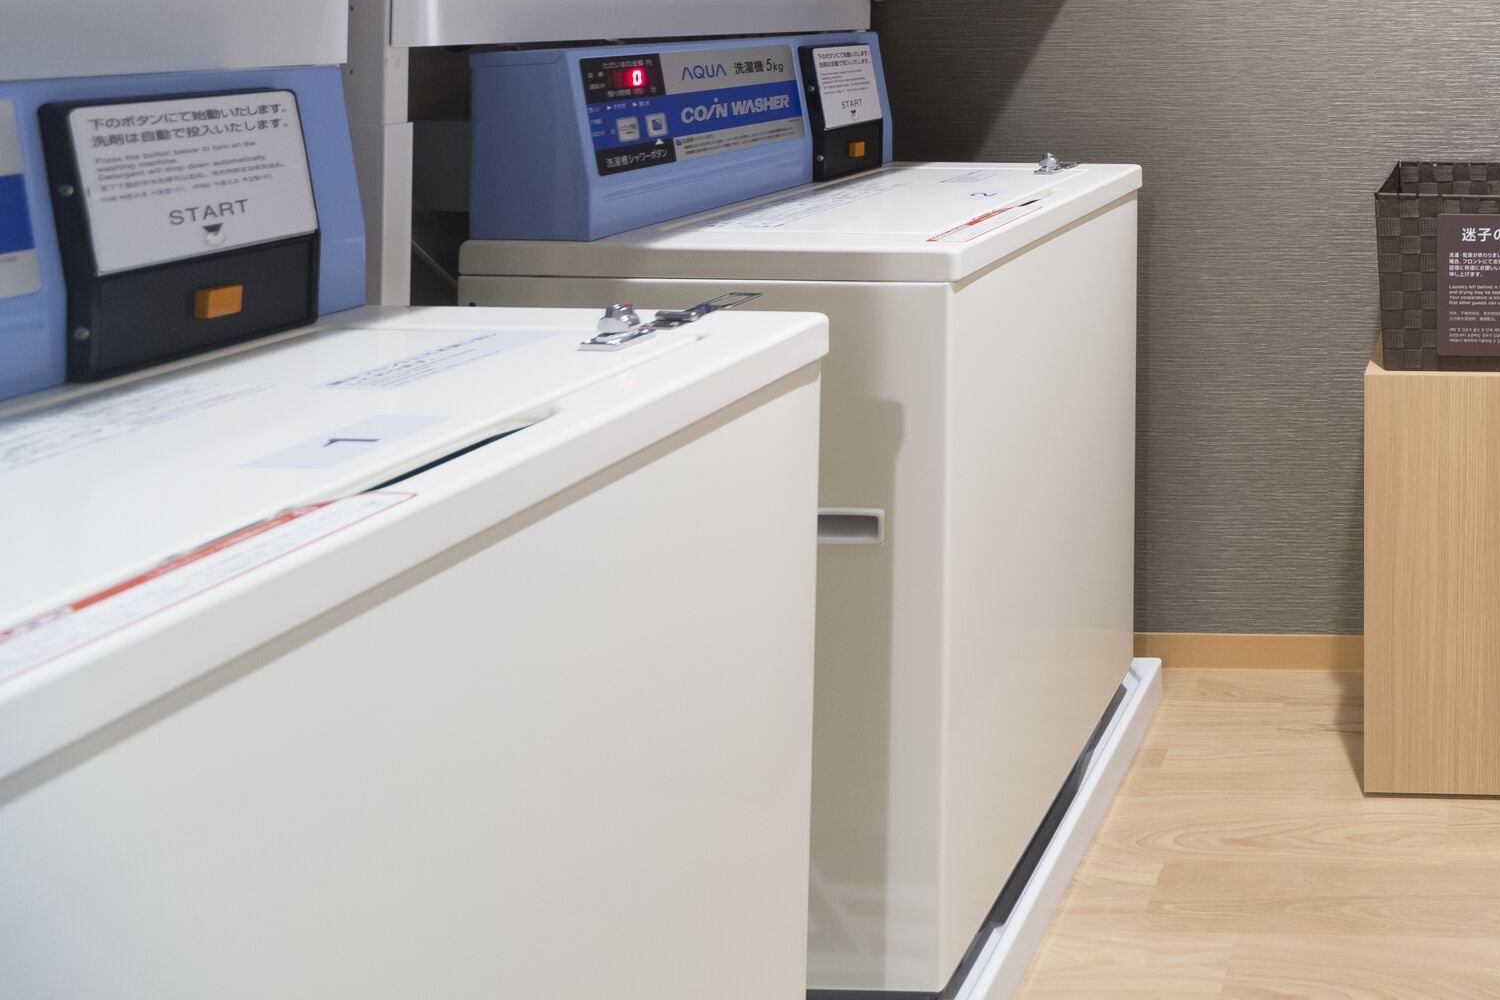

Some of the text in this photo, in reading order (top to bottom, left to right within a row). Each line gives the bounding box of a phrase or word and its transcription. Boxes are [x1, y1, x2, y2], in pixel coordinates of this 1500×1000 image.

[632, 70, 642, 86] 0
[681, 58, 784, 80] AQUA 洗濯機 5kg
[89, 103, 287, 131] 下のボタンにて始動いたします。
[680, 94, 790, 124] COIN WASHER
[841, 98, 862, 109] START
[92, 118, 288, 148] 洗剤は自動で投入いたします。
[169, 198, 249, 225] START
